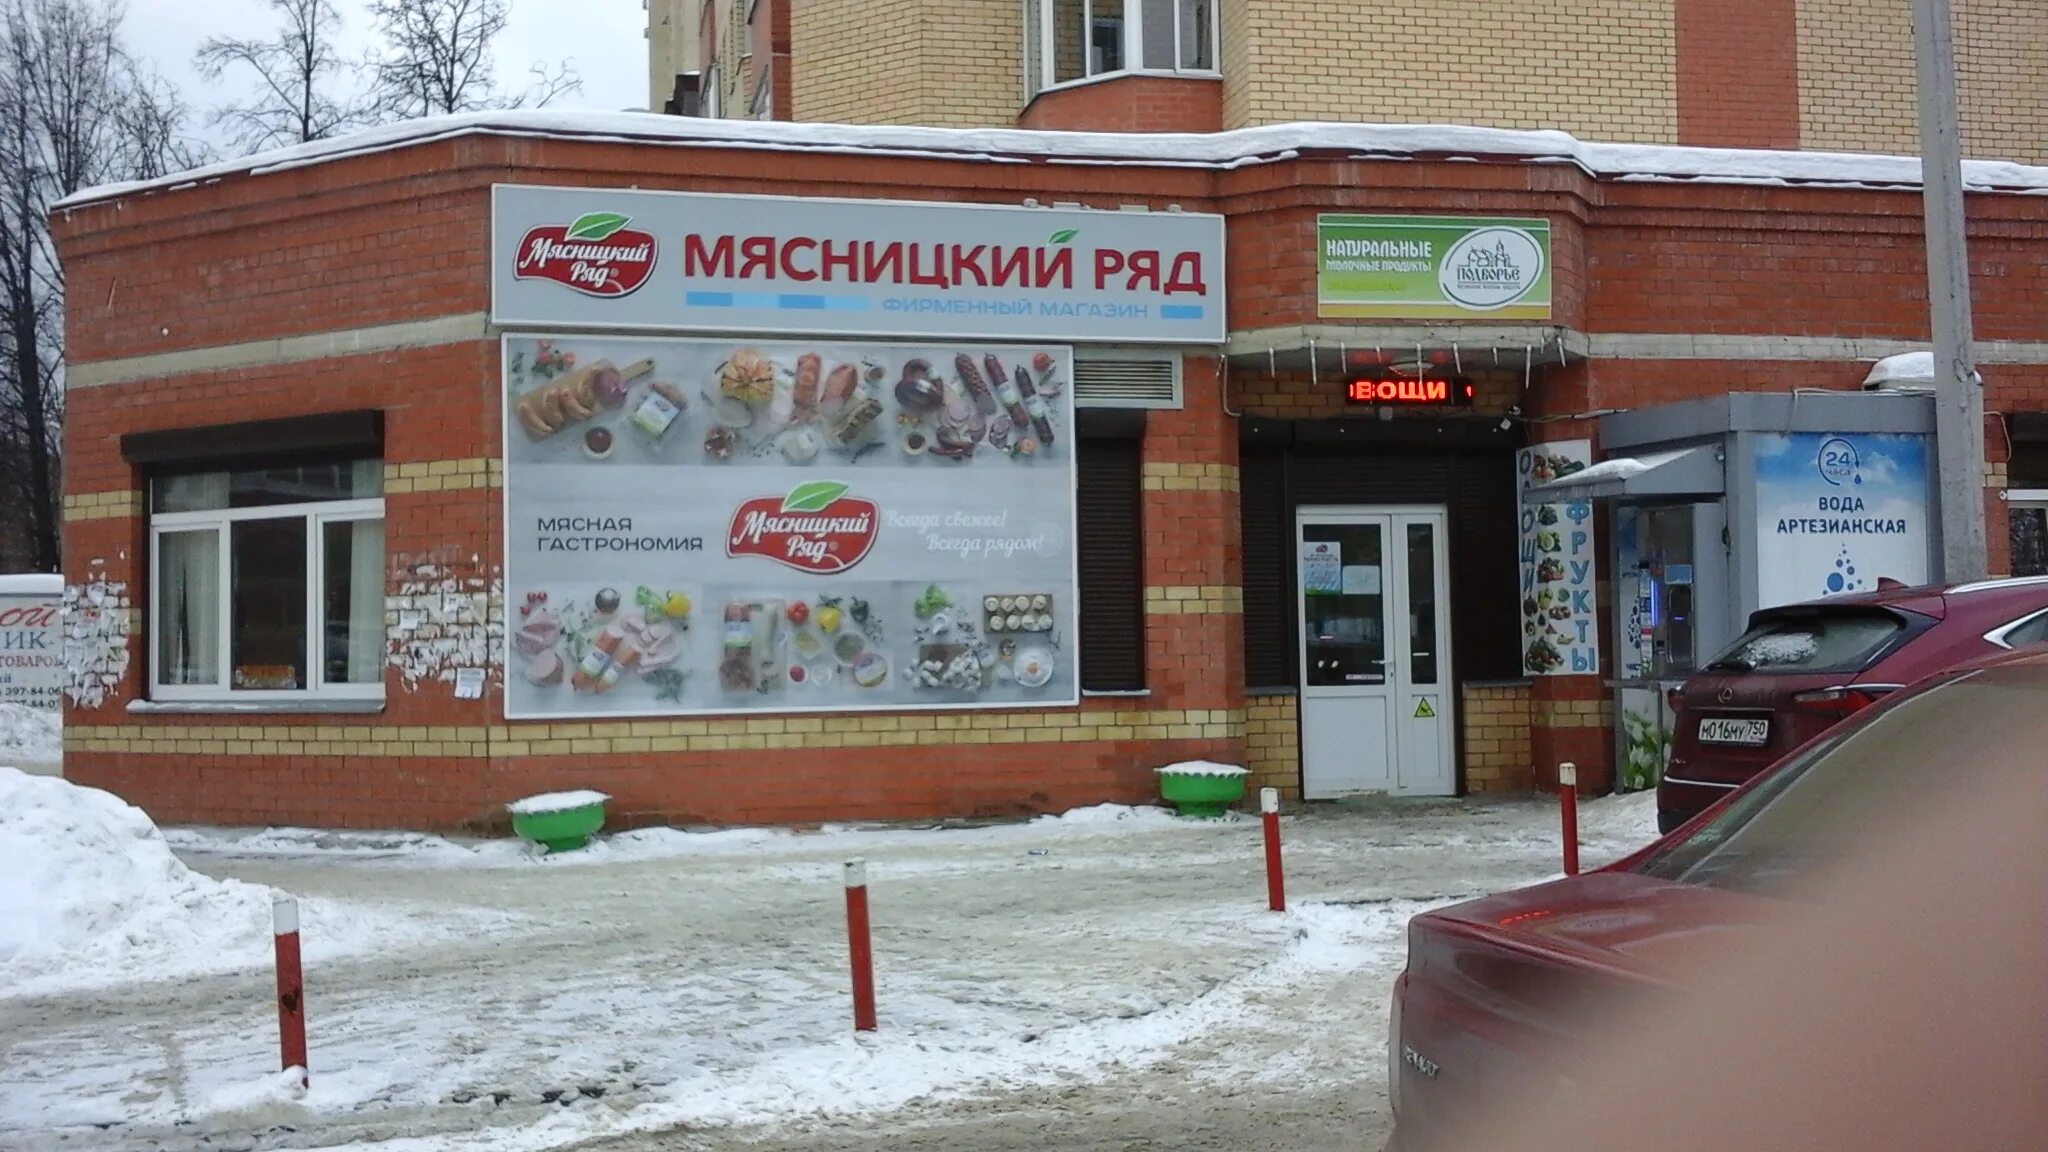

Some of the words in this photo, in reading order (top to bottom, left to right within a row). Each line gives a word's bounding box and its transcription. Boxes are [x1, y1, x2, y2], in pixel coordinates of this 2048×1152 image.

[519, 237, 651, 269] Мясницкий
[1326, 239, 1432, 258] НАТУРАЛЬНЫЕ
[685, 230, 1075, 289] МЯСНИЦКИЙ
[1094, 248, 1206, 296] РЯД
[1326, 260, 1380, 272] МОЛОЧНЫЕ
[1382, 260, 1432, 272] ПРОДУКТЫ
[882, 296, 1033, 316] ФИРМЕННЫЙ
[1040, 301, 1148, 318] МАГАЗИН
[1826, 451, 1850, 467] 24
[1819, 496, 1865, 513] ВОДА
[537, 517, 633, 532] МЯСНАЯ
[732, 511, 872, 545] Мясницкий
[886, 509, 941, 534] Всегда
[944, 510, 1007, 528] свежее!
[1777, 517, 1906, 535] АРТЕЗИАНСКАЯ
[537, 537, 704, 552] ГАСТРОНОМИЯ
[926, 533, 982, 558] Всегда
[984, 534, 1045, 559] рядом!
[1565, 498, 1596, 672] ФРУКТЫ
[1748, 721, 1766, 736] 750
